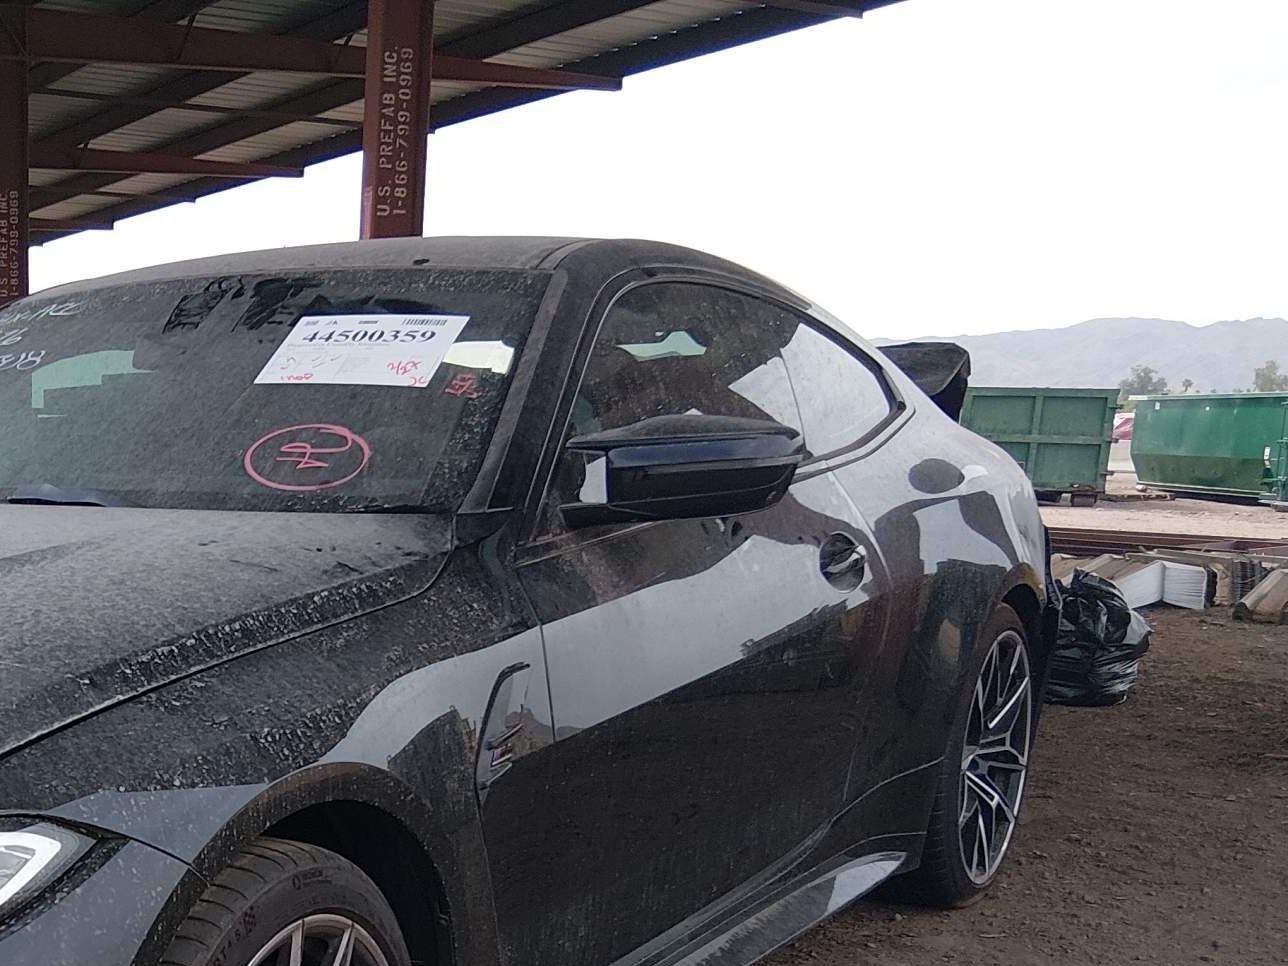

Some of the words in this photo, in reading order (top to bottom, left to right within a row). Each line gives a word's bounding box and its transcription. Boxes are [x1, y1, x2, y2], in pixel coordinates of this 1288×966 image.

[383, 46, 398, 83] INC.
[379, 93, 395, 169] PREFAB
[393, 48, 413, 215] 1-866-799-0969
[377, 180, 391, 216] U.S.
[302, 330, 437, 344] 44500359
